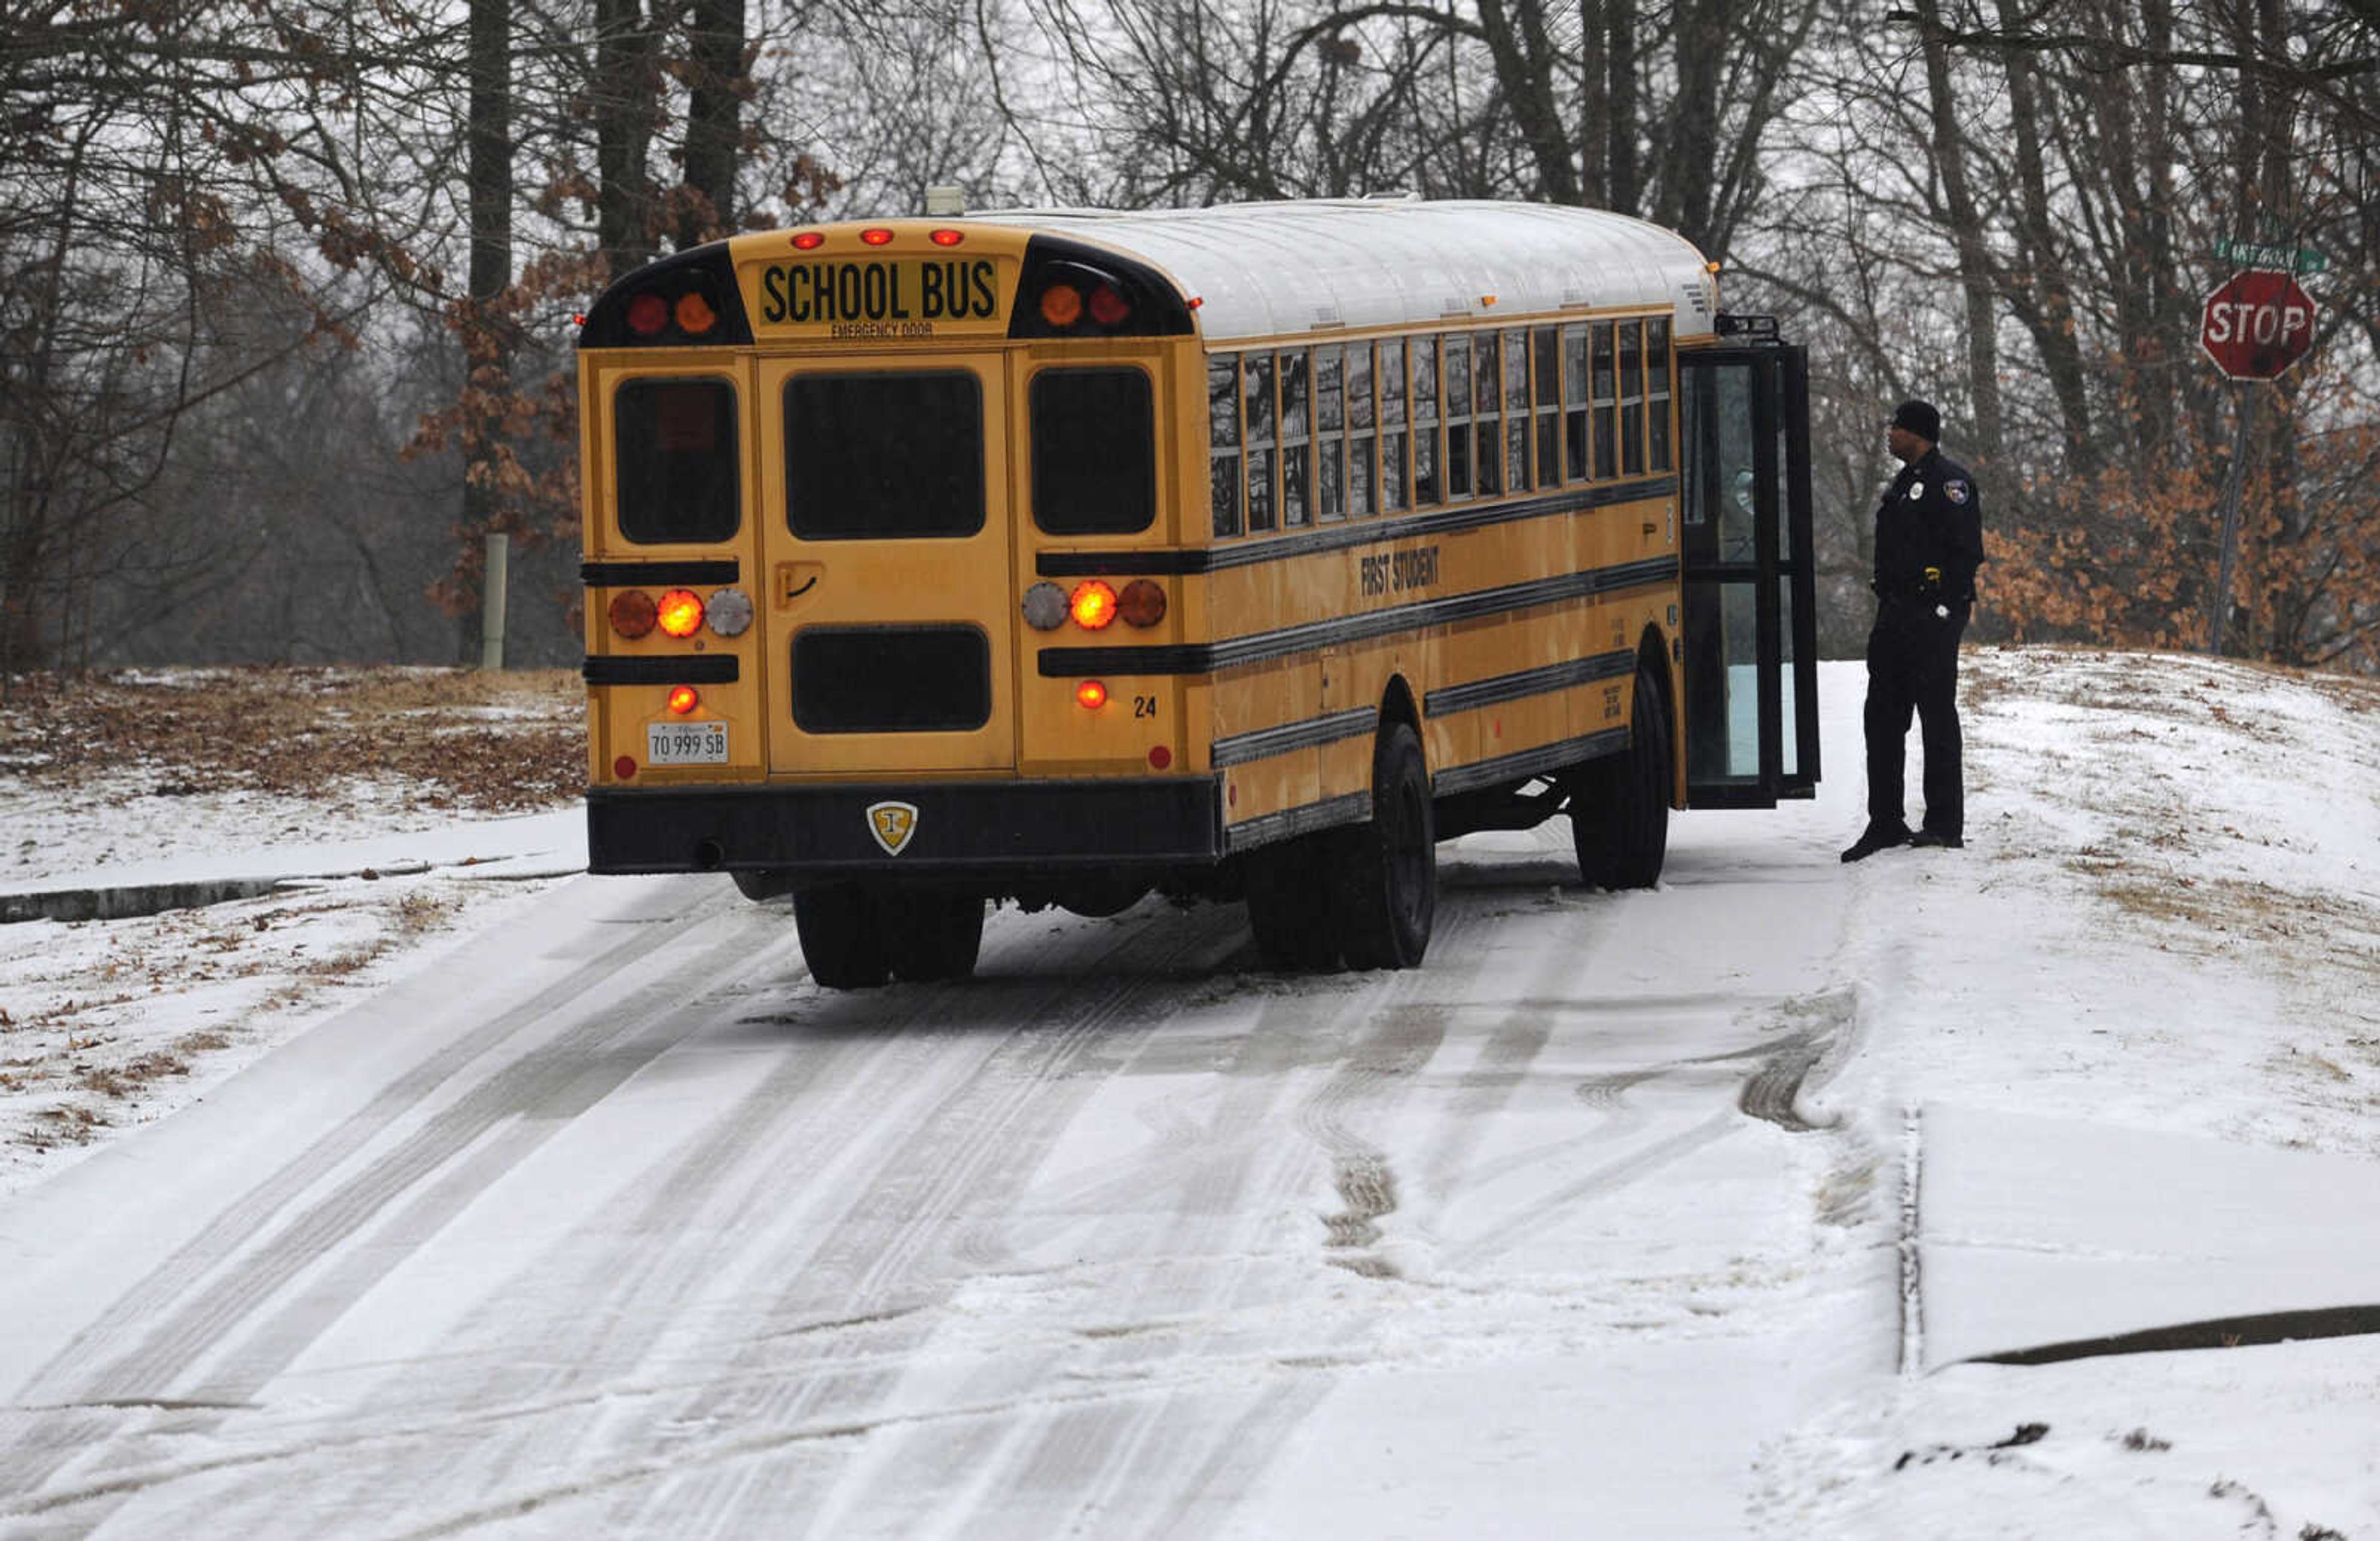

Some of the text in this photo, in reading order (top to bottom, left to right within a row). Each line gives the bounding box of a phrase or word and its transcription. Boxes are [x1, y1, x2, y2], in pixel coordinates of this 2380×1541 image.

[764, 260, 995, 322] SCHOOL BUS
[832, 322, 932, 338] EMERGENCY DOOR
[2208, 302, 2306, 345] STOP
[1361, 545, 1439, 596] FIRST STUDENT
[1134, 695, 1156, 719] 24
[651, 733, 724, 756] 70 999 SB
